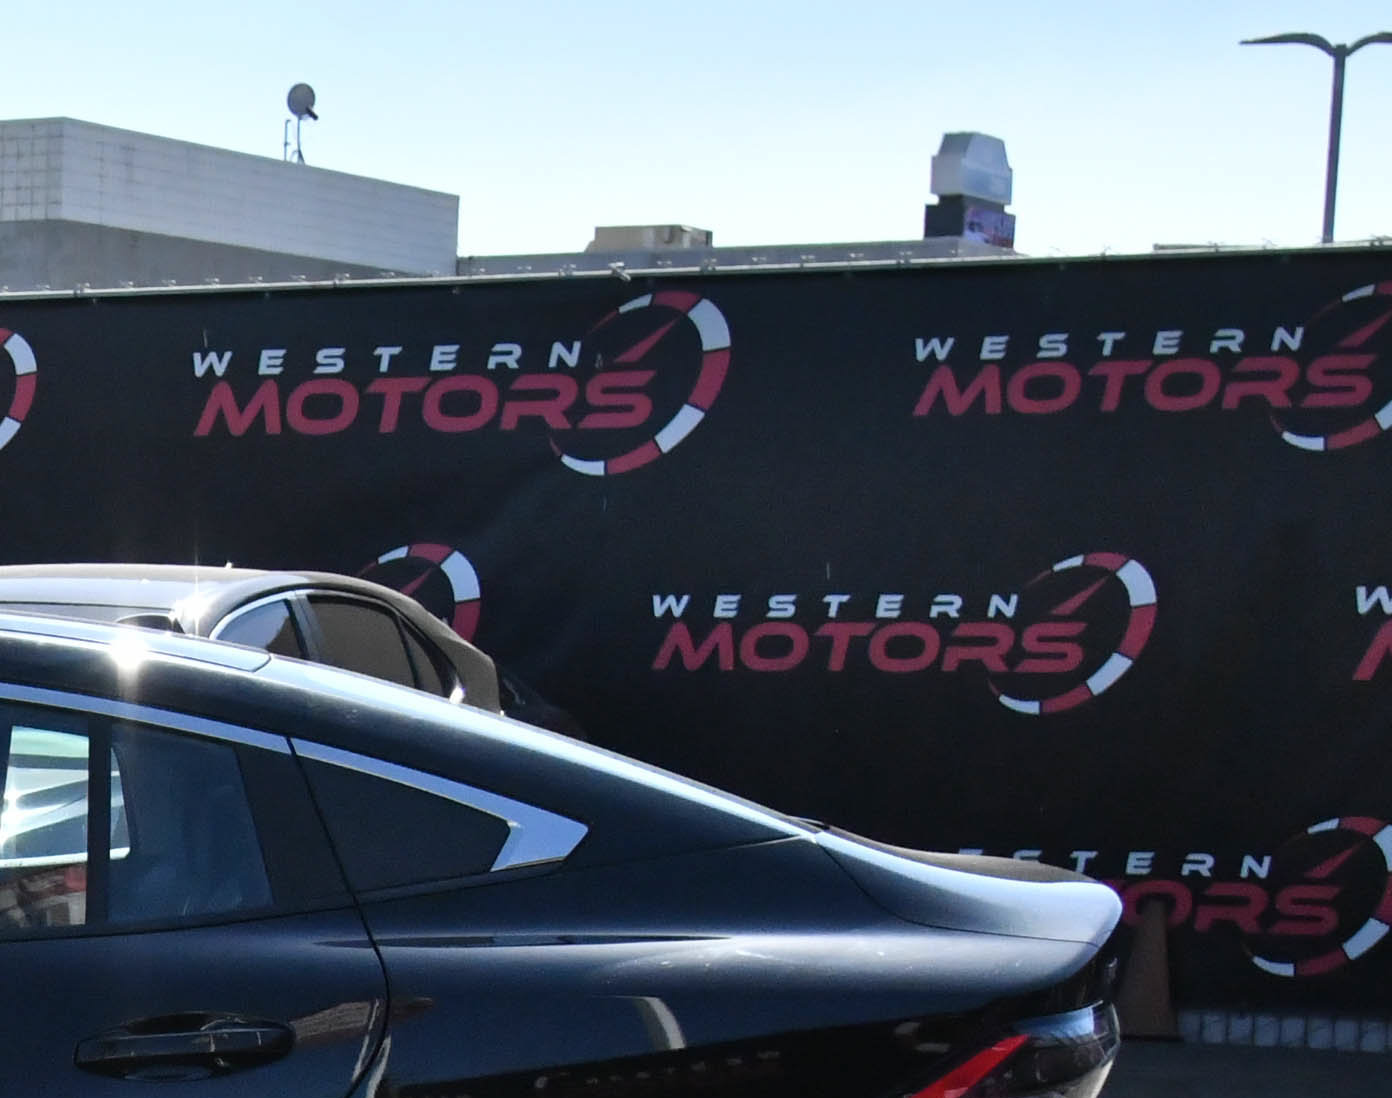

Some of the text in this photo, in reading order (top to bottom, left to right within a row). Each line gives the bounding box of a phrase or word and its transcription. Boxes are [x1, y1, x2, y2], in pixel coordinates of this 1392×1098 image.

[192, 340, 582, 378] WESTERN
[915, 326, 1305, 362] WESTERN
[193, 370, 657, 438] MOTORS
[913, 354, 1378, 417] MOTORS
[652, 594, 1019, 619] WESTERN
[652, 620, 1087, 673] MOTORS
